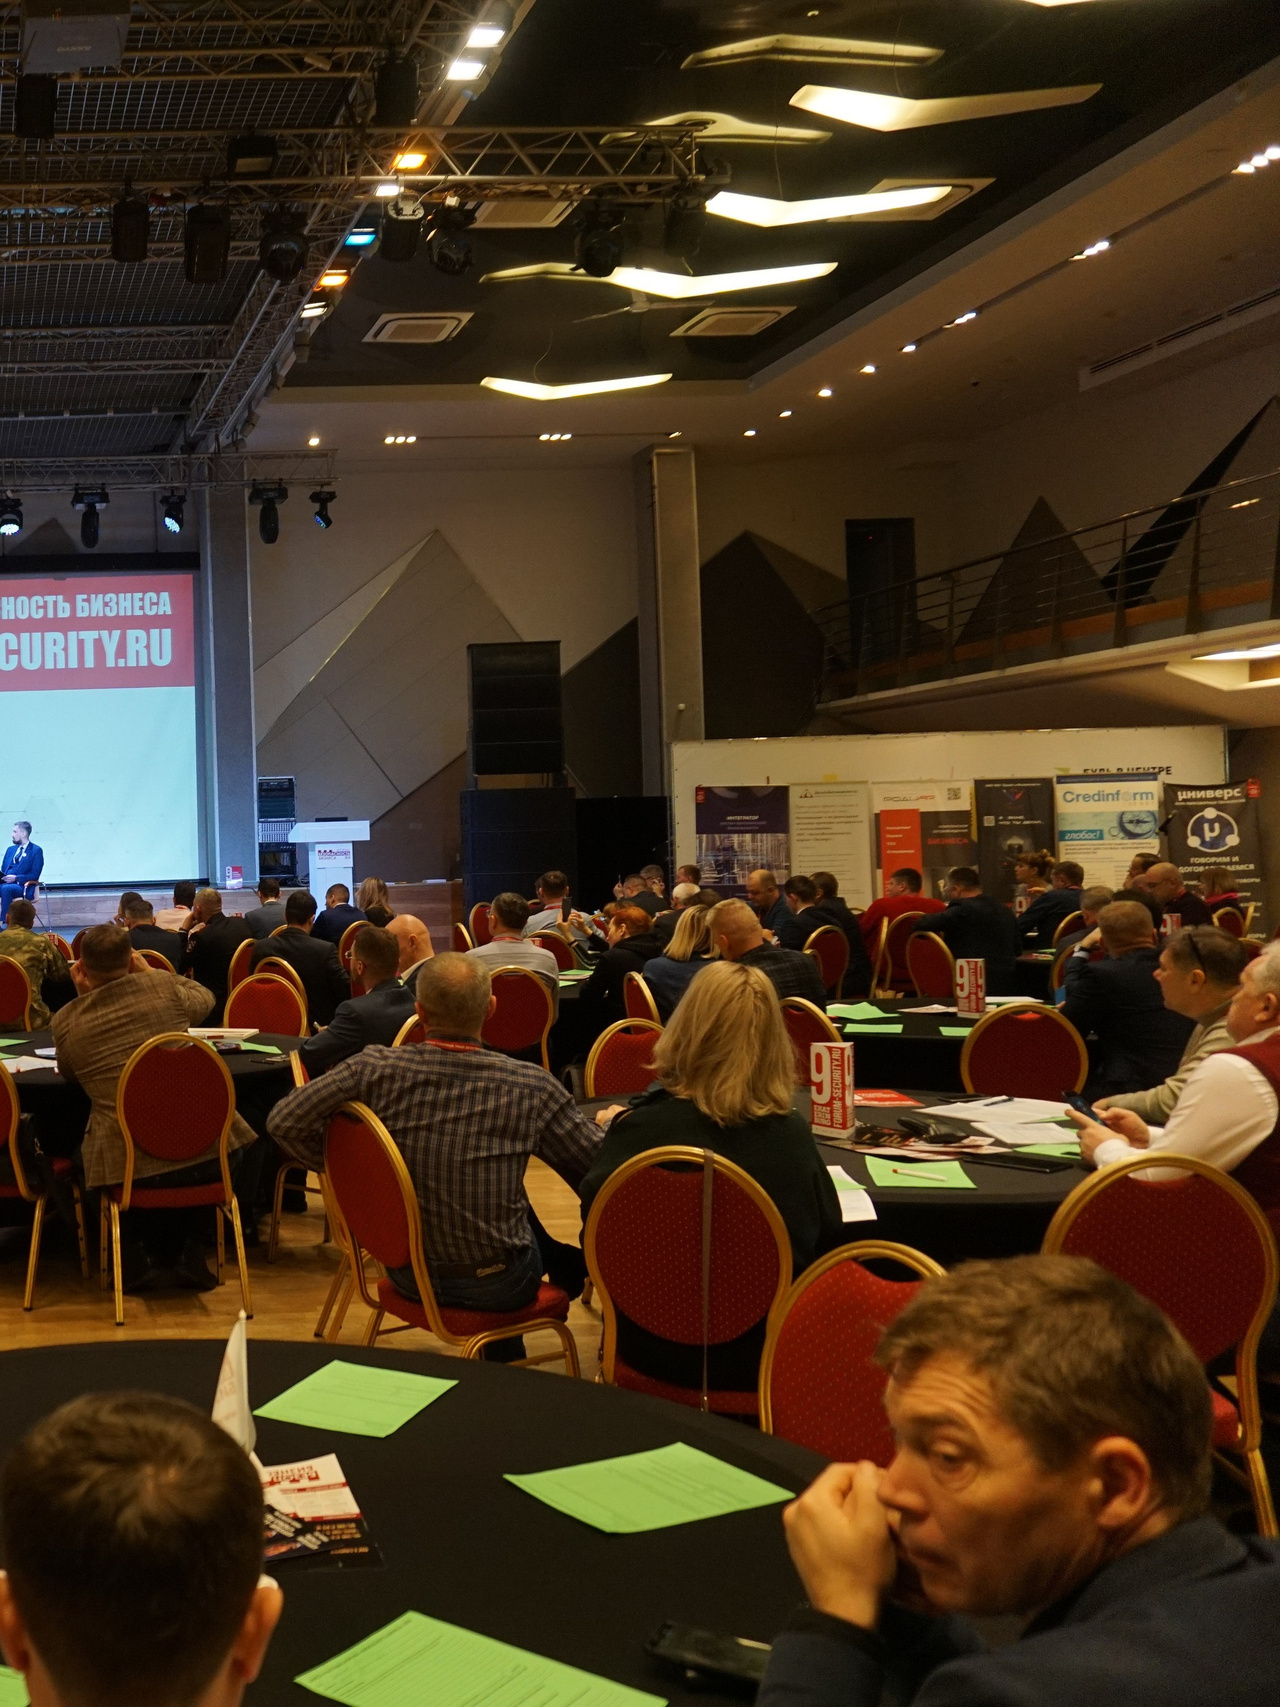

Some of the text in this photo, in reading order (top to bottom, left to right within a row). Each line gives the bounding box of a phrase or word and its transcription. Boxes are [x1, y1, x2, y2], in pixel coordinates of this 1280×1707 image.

[76, 592, 172, 618] БИЗНЕСА
[1063, 790, 1154, 803] Credinform
[1190, 856, 1230, 864] ГОВОРИМ
[956, 960, 969, 998] 9
[810, 1044, 831, 1104] 9
[831, 1048, 843, 1128] FORUM-SECURITY.RU
